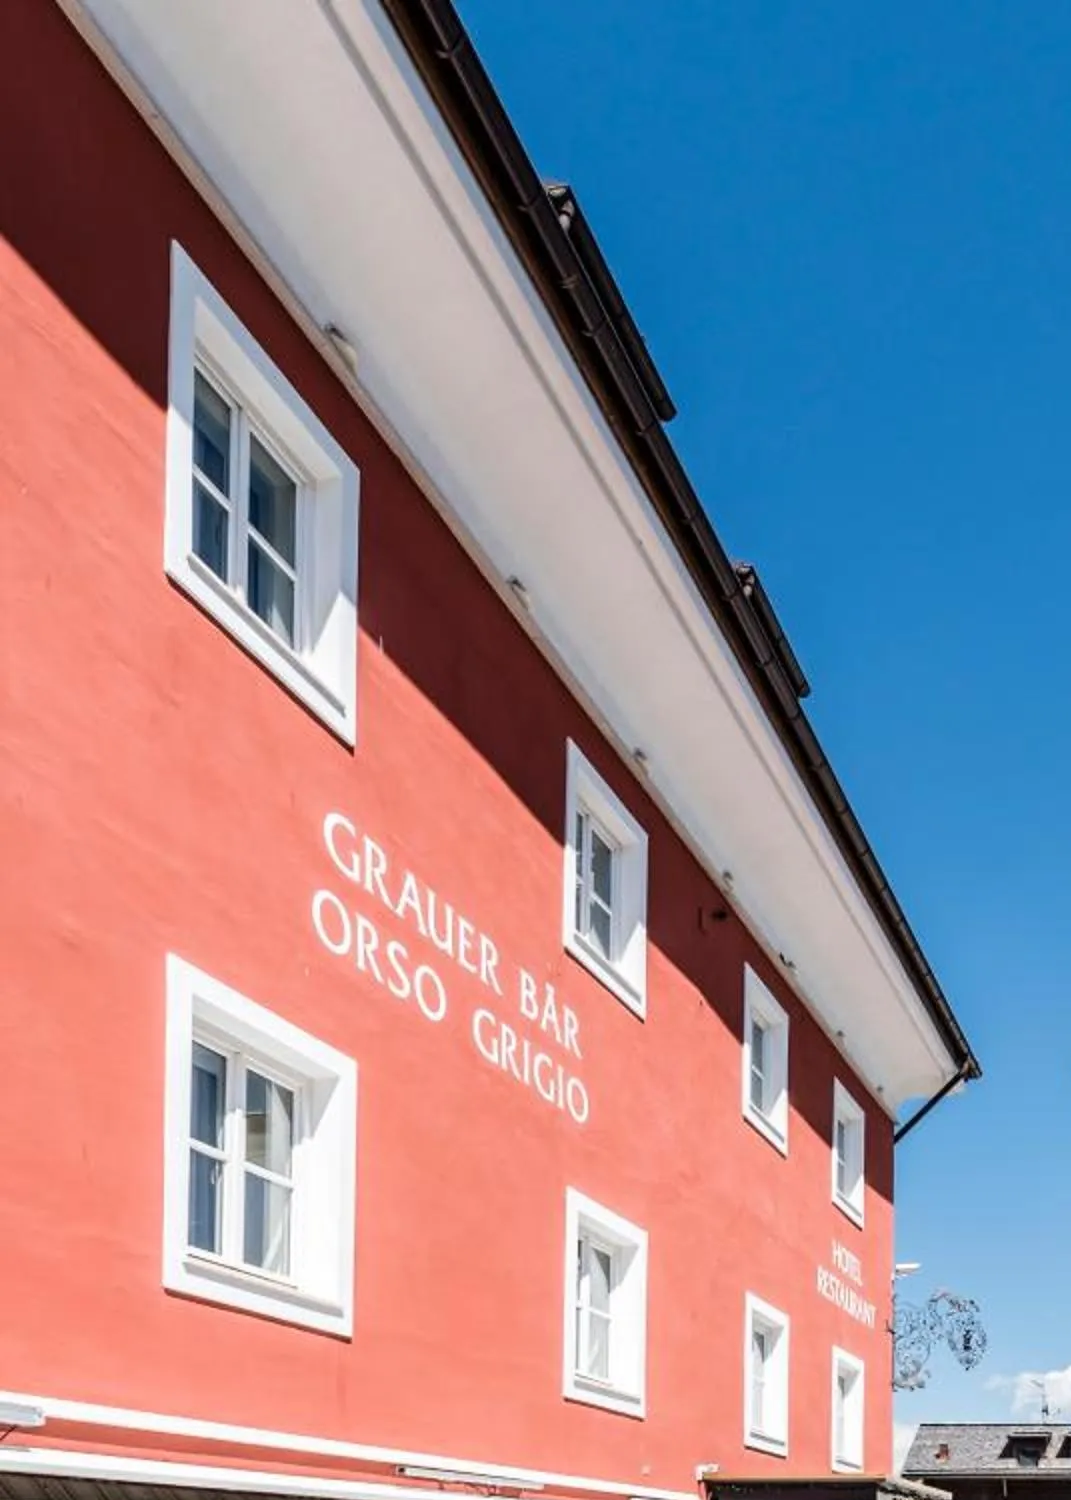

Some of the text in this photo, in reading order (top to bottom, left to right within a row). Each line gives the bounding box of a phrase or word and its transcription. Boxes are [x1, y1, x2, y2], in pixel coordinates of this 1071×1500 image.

[323, 812, 504, 996] GRAUER
[311, 889, 589, 1123] ORSO GRIGIO
[817, 1265, 877, 1329] RESTAURANT
